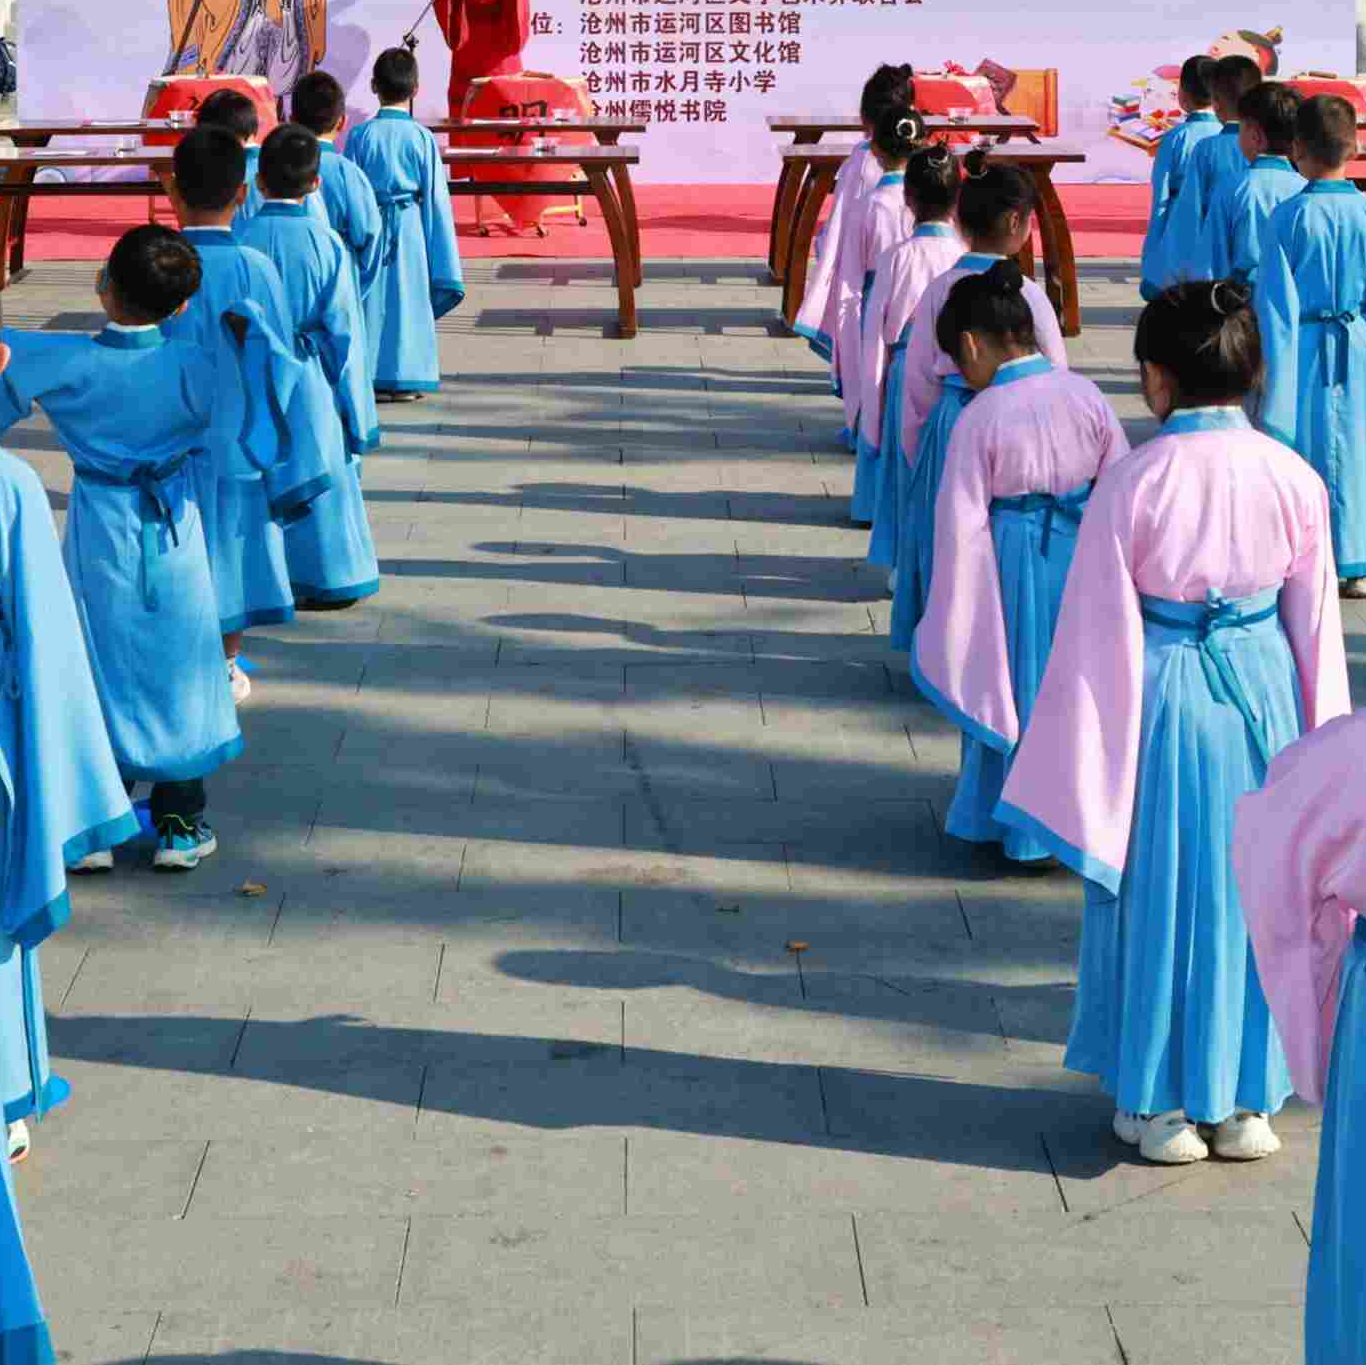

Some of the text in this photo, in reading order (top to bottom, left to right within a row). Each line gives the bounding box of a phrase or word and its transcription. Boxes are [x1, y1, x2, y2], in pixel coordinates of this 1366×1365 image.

[580, 40, 802, 64] 沧州市运河区文化馆
[581, 70, 777, 94] 沧州市水月寺小学
